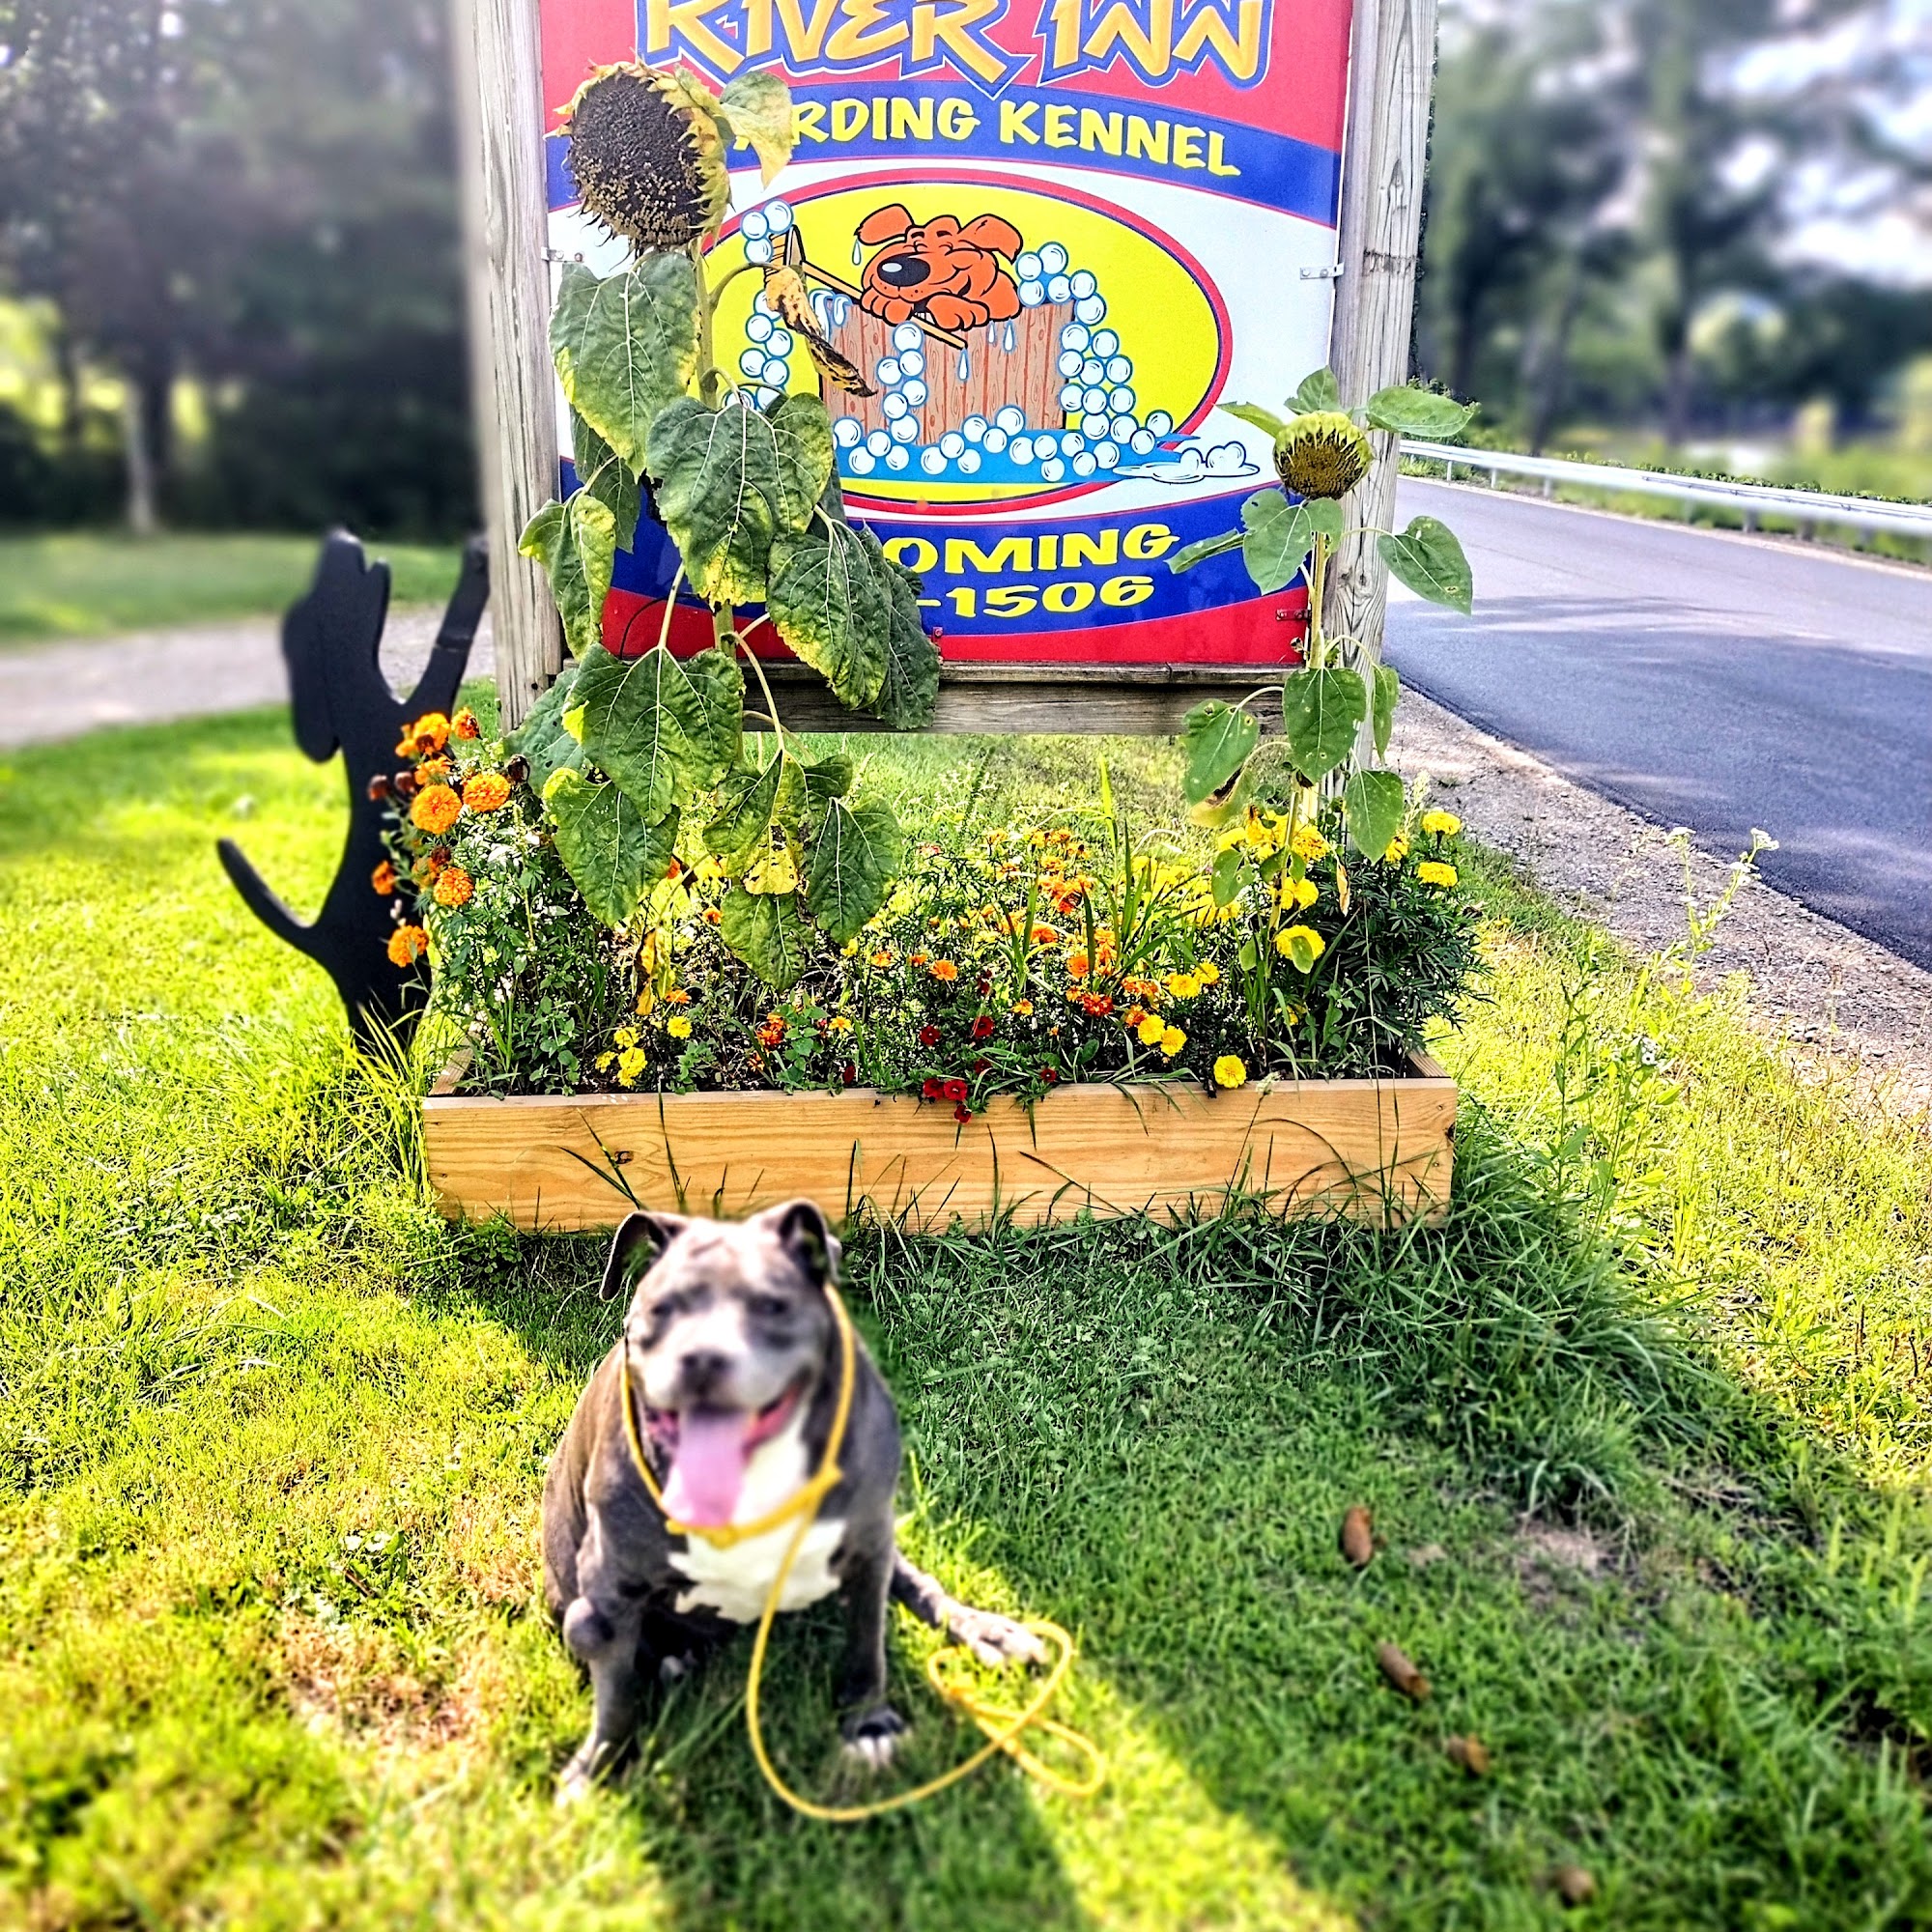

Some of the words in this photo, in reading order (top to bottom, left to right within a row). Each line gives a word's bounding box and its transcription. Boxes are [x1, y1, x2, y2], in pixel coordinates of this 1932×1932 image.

[638, 0, 1022, 94] RIVER
[732, 94, 979, 152] RDING
[1000, 98, 1241, 177] KENNEL
[881, 523, 1180, 575] OMING
[915, 575, 1155, 619] -1506
